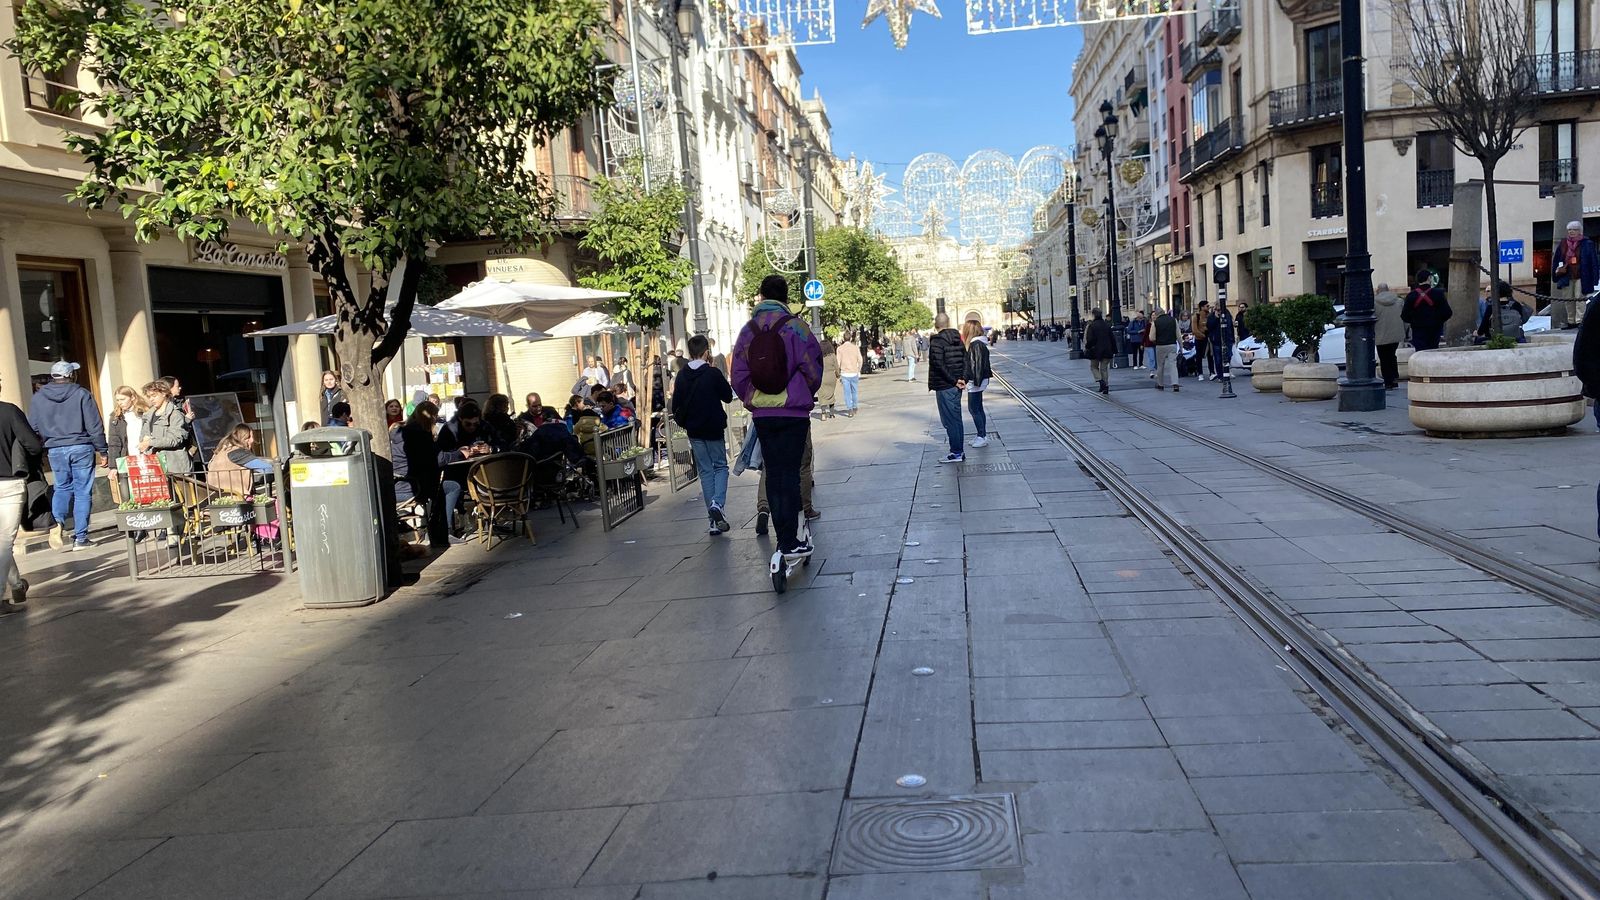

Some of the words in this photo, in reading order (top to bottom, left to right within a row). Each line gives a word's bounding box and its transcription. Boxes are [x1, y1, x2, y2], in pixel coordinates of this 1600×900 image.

[198, 240, 225, 264] La
[224, 242, 288, 270] Canasta
[1501, 247, 1523, 256] TAXI
[488, 265, 523, 273] VINUESA
[125, 513, 163, 528] Canasta
[219, 510, 257, 524] Canasta
